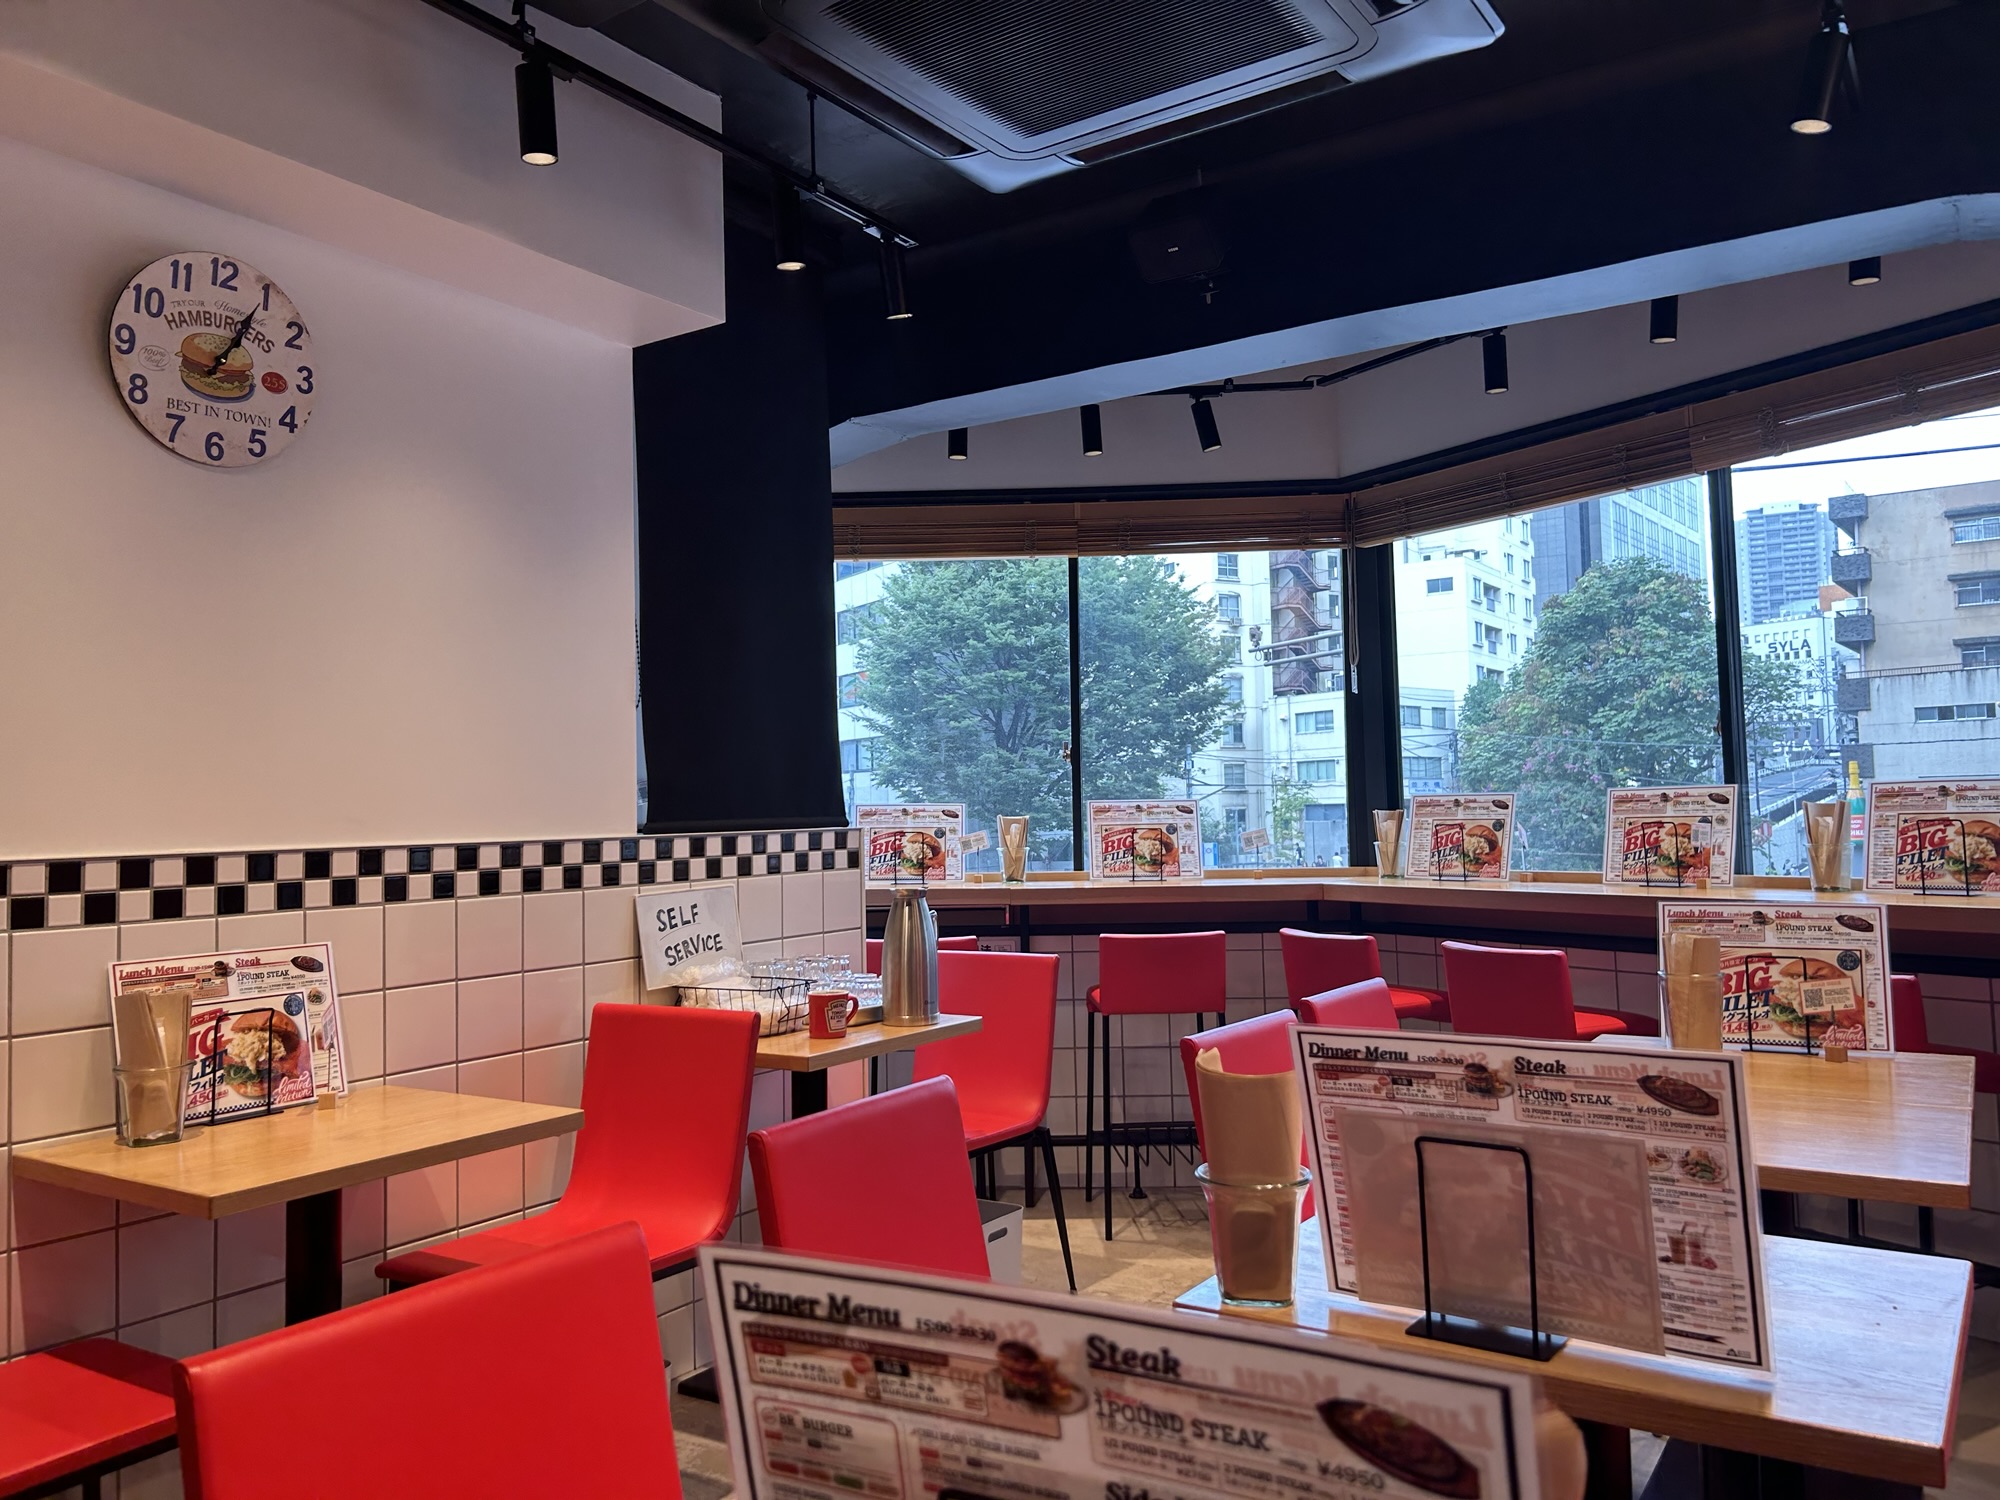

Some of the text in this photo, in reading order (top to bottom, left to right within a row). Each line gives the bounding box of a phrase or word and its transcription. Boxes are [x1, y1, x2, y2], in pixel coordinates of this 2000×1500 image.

[170, 259, 193, 292] 11
[210, 257, 240, 292] 12
[132, 283, 165, 318] 10
[261, 283, 271, 311] 1
[114, 323, 136, 354] 9
[164, 310, 275, 353] HAMBURGERS
[284, 321, 304, 350] 2
[127, 373, 148, 404] 8
[296, 366, 313, 394] 3
[166, 397, 271, 428] BEST IN TOWN!
[278, 405, 298, 433] 4
[165, 413, 186, 443] 7
[204, 431, 224, 461] 6
[248, 429, 267, 458] 5
[1768, 639, 1811, 653] SYLA
[1772, 740, 1812, 752] SYLA
[871, 838, 903, 857] BIG
[1103, 835, 1134, 854] BIG
[1432, 831, 1461, 852] BIG
[1624, 845, 1661, 861] FILET
[1625, 826, 1661, 853] BIG
[1898, 828, 1948, 855] BIG
[1897, 846, 1949, 865] FILET
[656, 903, 699, 932] SELF
[1667, 909, 1696, 918] Lunch
[1698, 909, 1724, 918] Menu
[1775, 910, 1802, 919] Steak
[235, 956, 261, 968] Steak
[664, 933, 723, 966] SERVICE
[119, 966, 152, 980] Lunch
[155, 965, 185, 977] Menu
[267, 970, 290, 979] STEAK
[1723, 989, 1774, 1011] ILET
[188, 1024, 225, 1060] IG
[1308, 1042, 1464, 1065] Dinner Menu 15:00-20:30
[190, 1049, 228, 1081] LET
[1514, 1056, 1566, 1075] Steak
[1570, 1093, 1613, 1105] STEAK
[1636, 1106, 1672, 1117] ¥4950
[732, 1280, 820, 1317] Dinner
[827, 1292, 901, 1327] Menu
[1086, 1334, 1181, 1378] Steak
[1191, 1417, 1270, 1451] STEAK
[1316, 1459, 1385, 1489] ¥4950
